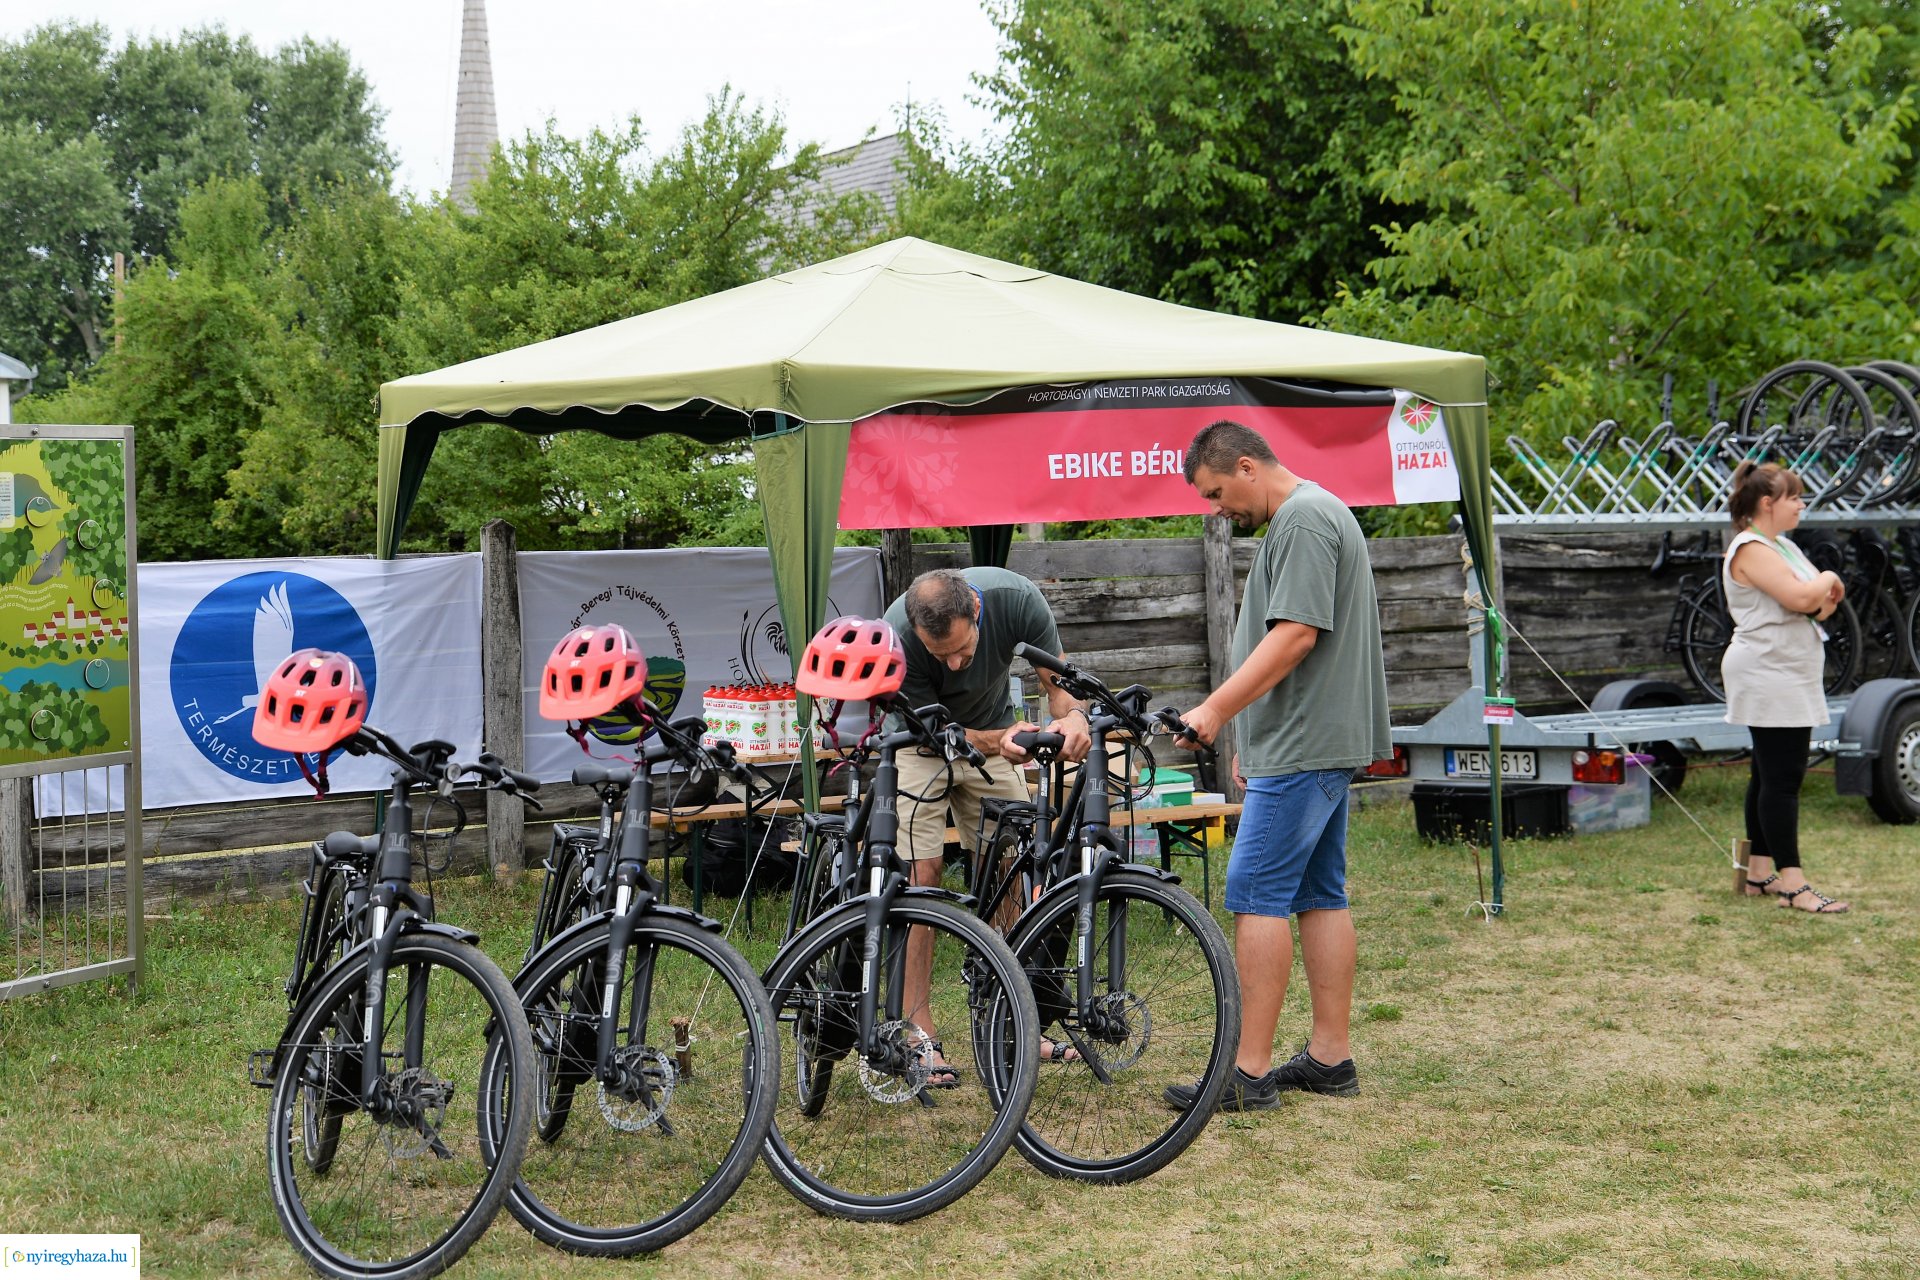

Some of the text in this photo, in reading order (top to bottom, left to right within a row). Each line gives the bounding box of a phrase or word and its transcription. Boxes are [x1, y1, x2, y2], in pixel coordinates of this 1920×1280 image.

[1027, 381, 1231, 403] HORTOBÁGYI NEMZETI PARK IGAZGATÓSÁG
[1048, 451, 1123, 480] EBIKE
[1397, 451, 1448, 471] HAZA!
[570, 585, 685, 661] ár-Beregi Tájvédelmi Körzet
